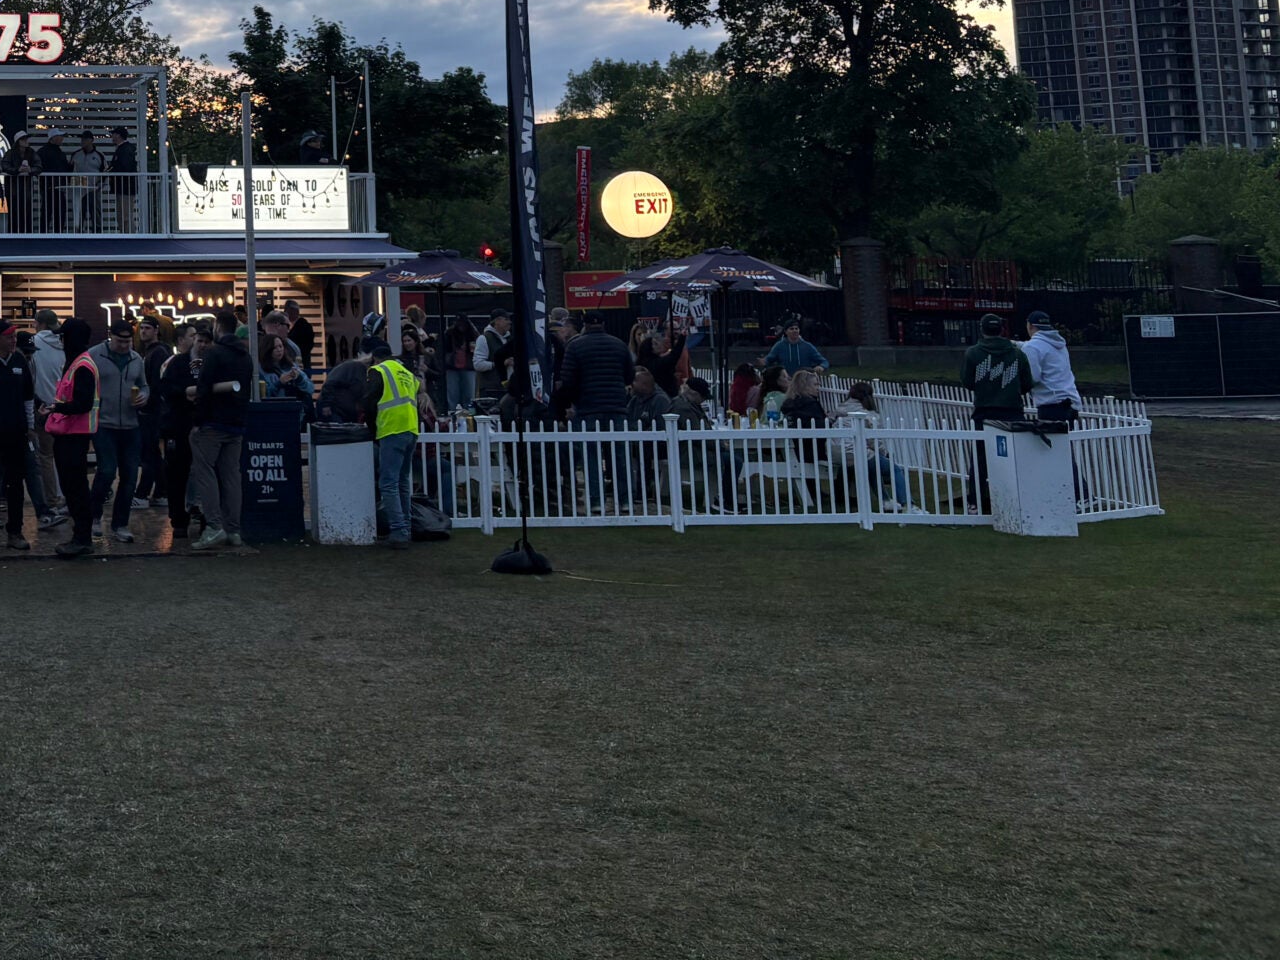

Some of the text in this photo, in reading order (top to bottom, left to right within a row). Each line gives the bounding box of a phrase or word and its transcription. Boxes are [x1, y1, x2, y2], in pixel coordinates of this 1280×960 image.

[203, 180, 229, 192] RAISE
[237, 180, 242, 191] A
[280, 180, 298, 192] CAN
[305, 180, 317, 191] TO
[579, 150, 588, 230] EMERGENCY
[232, 194, 290, 206] 50 EARS OF
[635, 199, 667, 214] EXIT
[232, 208, 287, 220] MILR TIME
[579, 232, 588, 259] EXIT
[250, 455, 283, 468] OPEN
[246, 469, 288, 482] TO ALL
[261, 485, 274, 494] 21+
